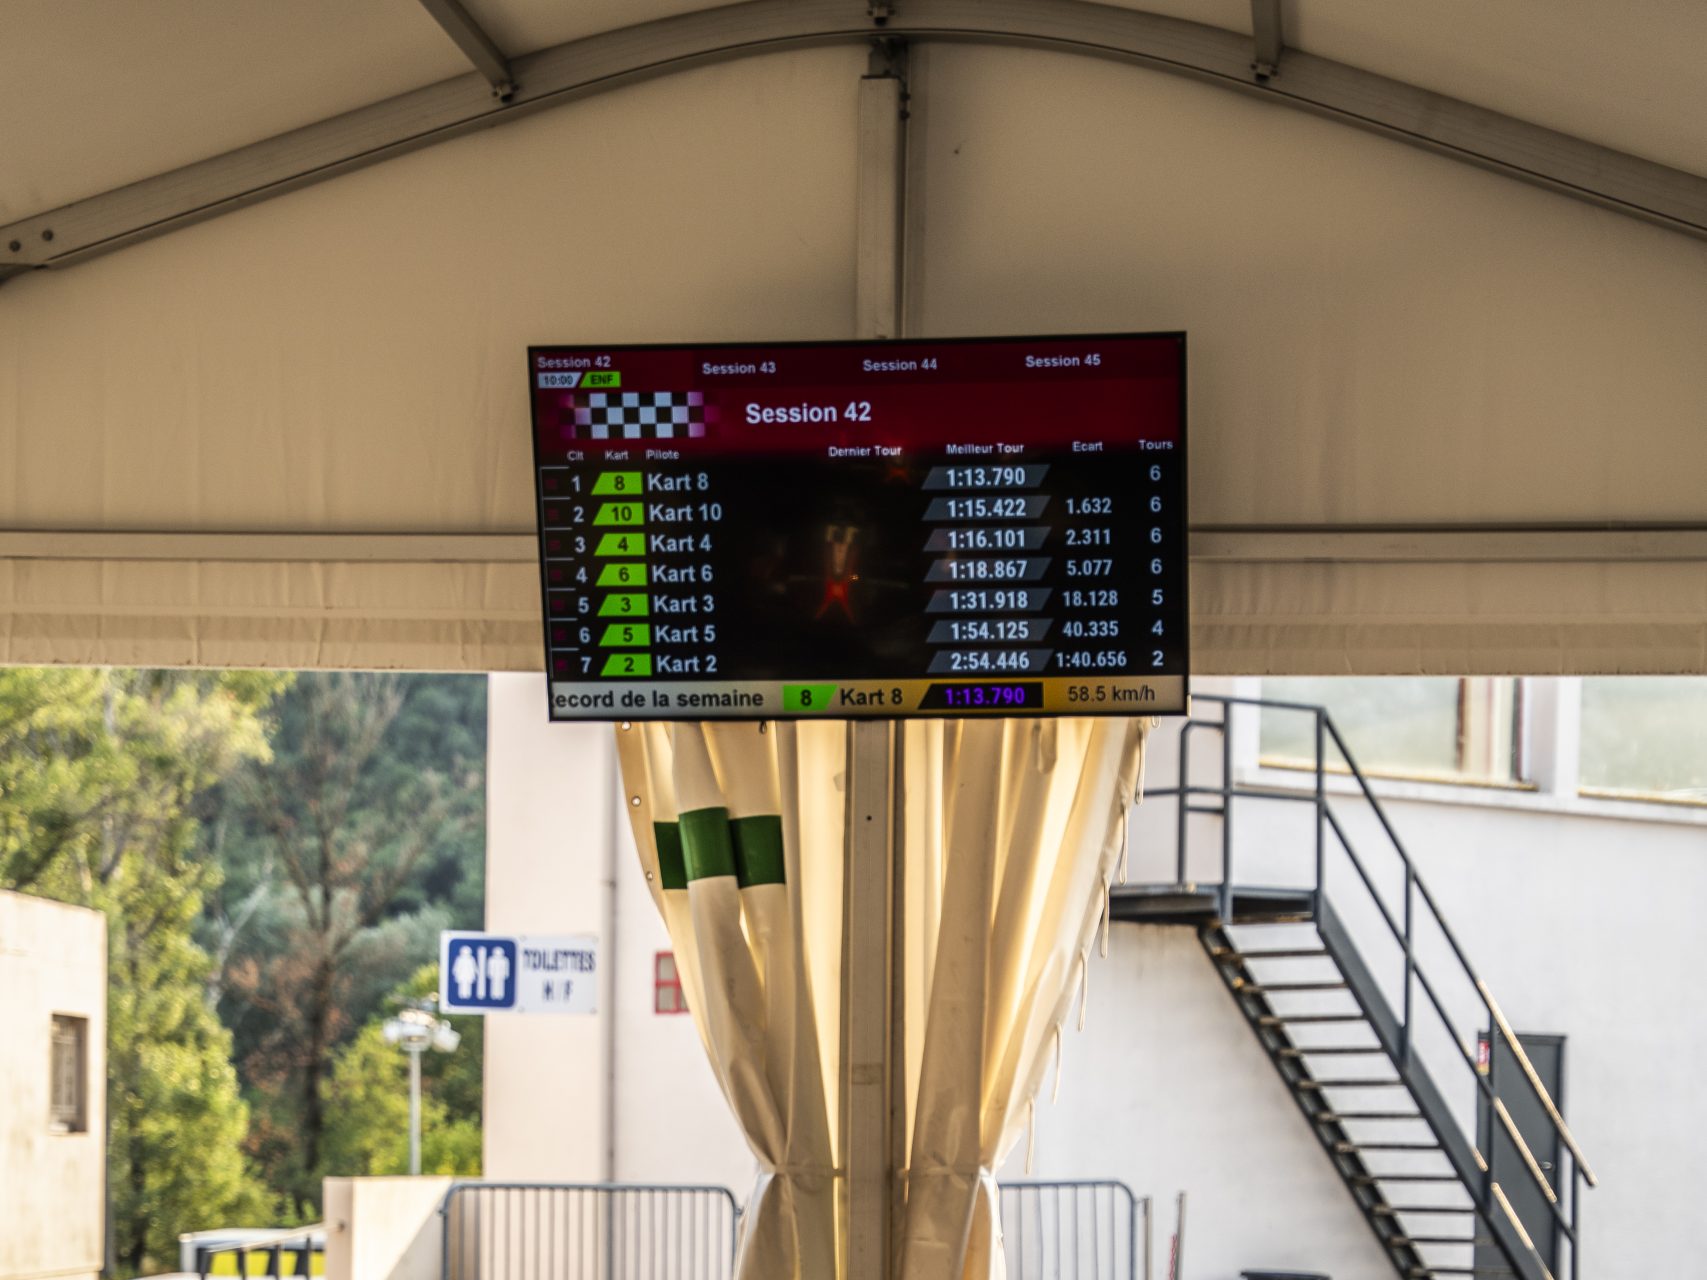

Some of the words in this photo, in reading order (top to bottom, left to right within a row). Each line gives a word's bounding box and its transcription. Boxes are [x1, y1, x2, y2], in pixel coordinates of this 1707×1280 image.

[537, 357, 591, 369] Session
[595, 357, 611, 367] 42
[863, 360, 917, 371] Session
[921, 358, 937, 370] 44
[1025, 355, 1080, 367] Session
[1084, 354, 1101, 366] 45
[703, 363, 756, 374] Session
[760, 362, 776, 373] 43
[543, 376, 573, 385] 10:00
[591, 375, 613, 385] ENF
[746, 403, 837, 424] Session
[844, 402, 872, 422] 42
[828, 445, 870, 457] Dernier
[875, 445, 901, 456] Tour
[946, 444, 993, 454] Meilleur
[998, 443, 1024, 453] Tour
[1072, 441, 1103, 452] Ecart
[1139, 439, 1173, 450] Tours
[567, 451, 584, 461] Clt
[605, 451, 628, 460] Kart
[646, 450, 679, 460] Pilote
[572, 477, 581, 491] 1
[615, 476, 625, 490] 8
[648, 474, 691, 491] Kart
[697, 474, 709, 490] 8
[947, 467, 1025, 486] 1:13.790
[1150, 465, 1161, 481] 6
[574, 507, 584, 522] 2
[612, 507, 632, 521] 10
[649, 505, 692, 521] Kart
[700, 504, 722, 520] 10
[947, 498, 1026, 517] 1:15.422
[1066, 498, 1112, 513] 1.632
[1150, 497, 1161, 512] 6
[575, 537, 586, 552] 3
[618, 538, 628, 551] 4
[651, 535, 694, 552] Kart
[700, 535, 712, 551] 4
[948, 530, 1025, 548] 1:16.101
[1066, 529, 1110, 545] 2.311
[1150, 528, 1161, 543] 6
[576, 568, 587, 583] 4
[619, 568, 629, 581] 6
[652, 566, 695, 582] Kart
[702, 566, 712, 581] 6
[949, 561, 1026, 579] 1:18.867
[1067, 560, 1112, 576] 5.077
[1151, 559, 1162, 574] 6
[578, 598, 589, 612] 5
[621, 598, 631, 611] 3
[654, 596, 697, 613] Kart
[703, 596, 714, 611] 3
[950, 592, 1028, 609] 1:31.918
[1063, 591, 1118, 606] 18.128
[1152, 590, 1163, 604] 5
[580, 628, 590, 643] 6
[623, 628, 633, 641] 5
[655, 626, 698, 642] Kart
[704, 626, 715, 641] 5
[951, 622, 1029, 640] 1:54.125
[1063, 621, 1118, 637] 40.335
[1152, 620, 1163, 636] 4
[581, 658, 592, 673] 7
[625, 658, 634, 671] 2
[657, 656, 700, 673] Kart
[706, 656, 717, 671] 2
[951, 653, 1029, 670] 2:54.446
[1056, 652, 1127, 667] 1:40.656
[1153, 651, 1163, 666] 2
[552, 691, 613, 709] ecord
[622, 691, 645, 708] de
[653, 691, 669, 707] la
[677, 690, 763, 707] semaine
[801, 691, 811, 706] 8
[841, 690, 884, 705] Kart
[892, 689, 902, 704] 8
[945, 687, 1025, 705] 1:13.790
[1068, 687, 1106, 702] 58.5
[1112, 685, 1155, 701] km/h
[522, 948, 595, 972] TOILETTES
